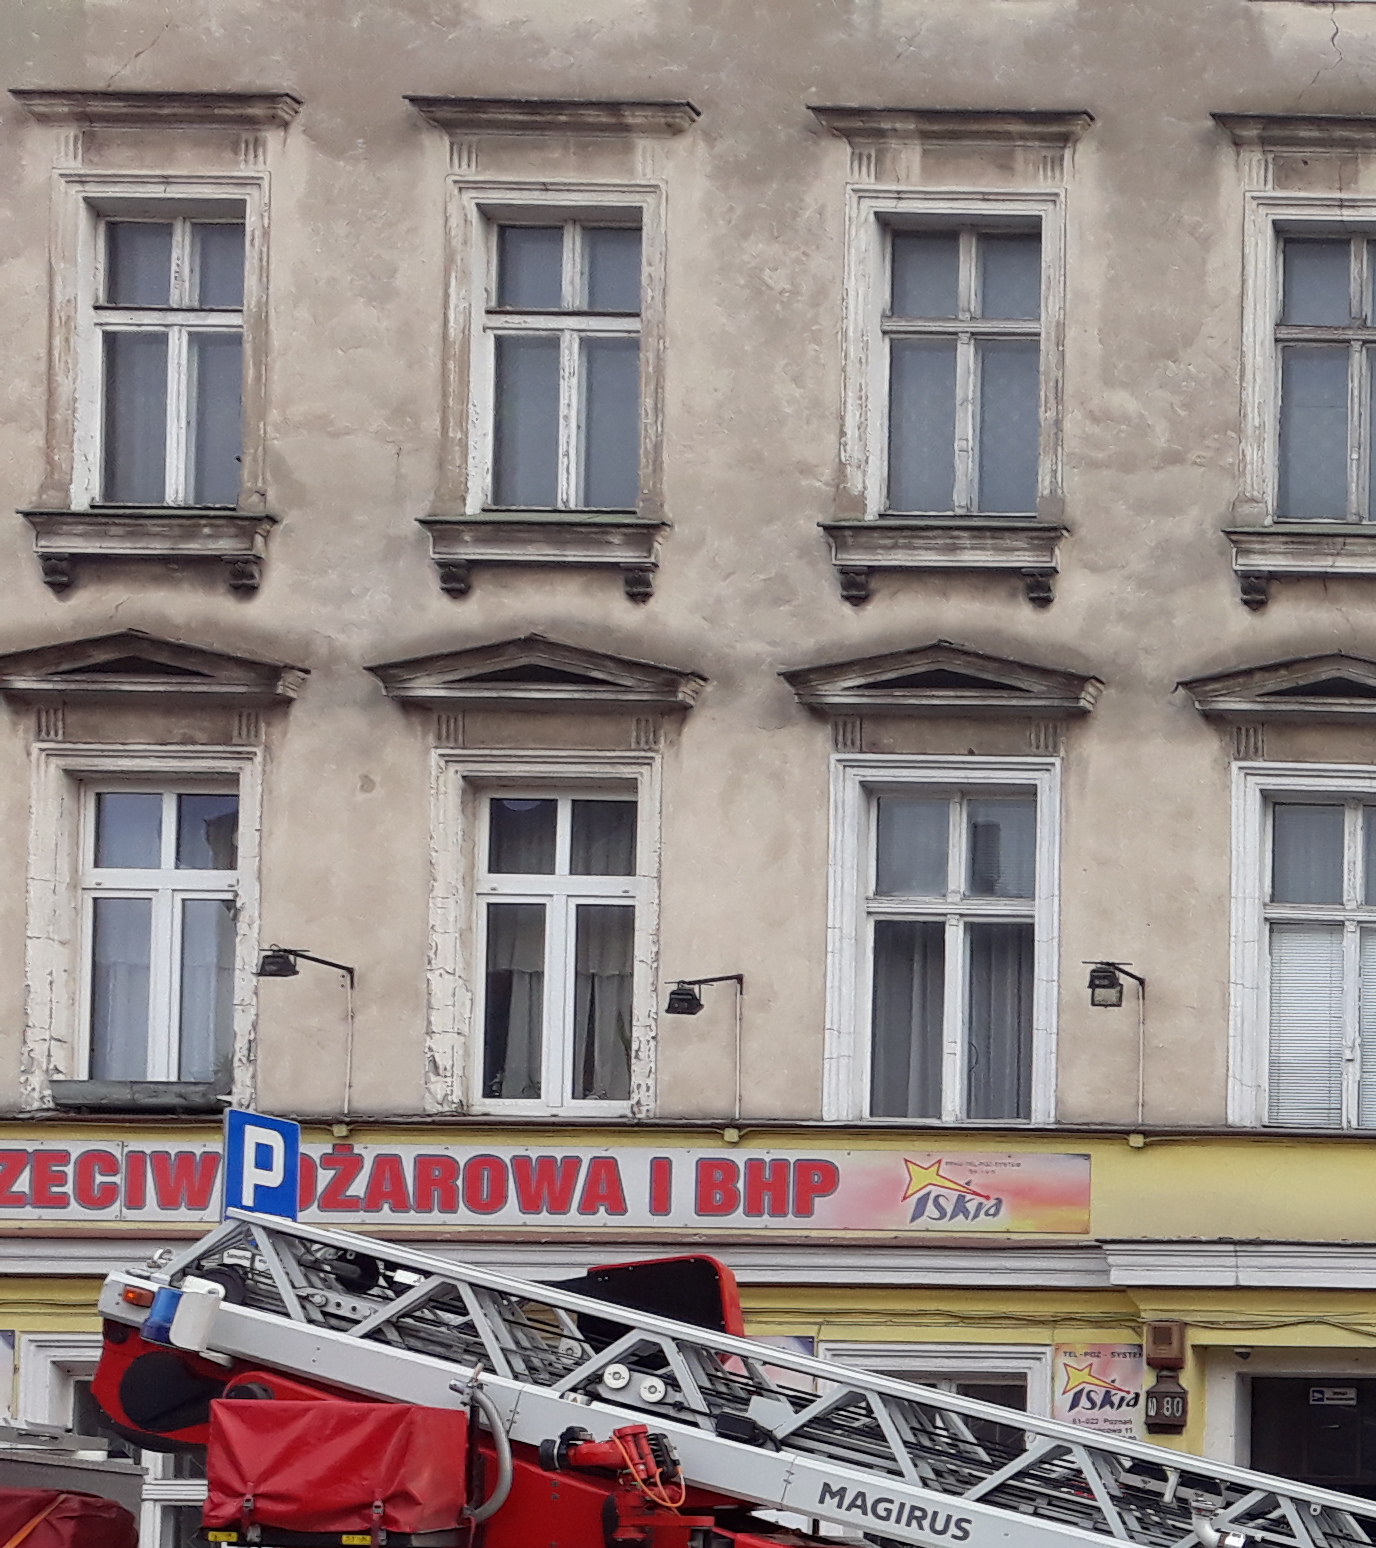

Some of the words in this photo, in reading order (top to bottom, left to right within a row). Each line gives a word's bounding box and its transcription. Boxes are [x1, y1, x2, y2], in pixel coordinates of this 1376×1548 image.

[241, 1124, 286, 1207] P
[648, 1156, 672, 1216] I
[694, 1157, 840, 1218] BHP
[1162, 1396, 1183, 1417] 80
[818, 1481, 973, 1542] MAGIRUS
